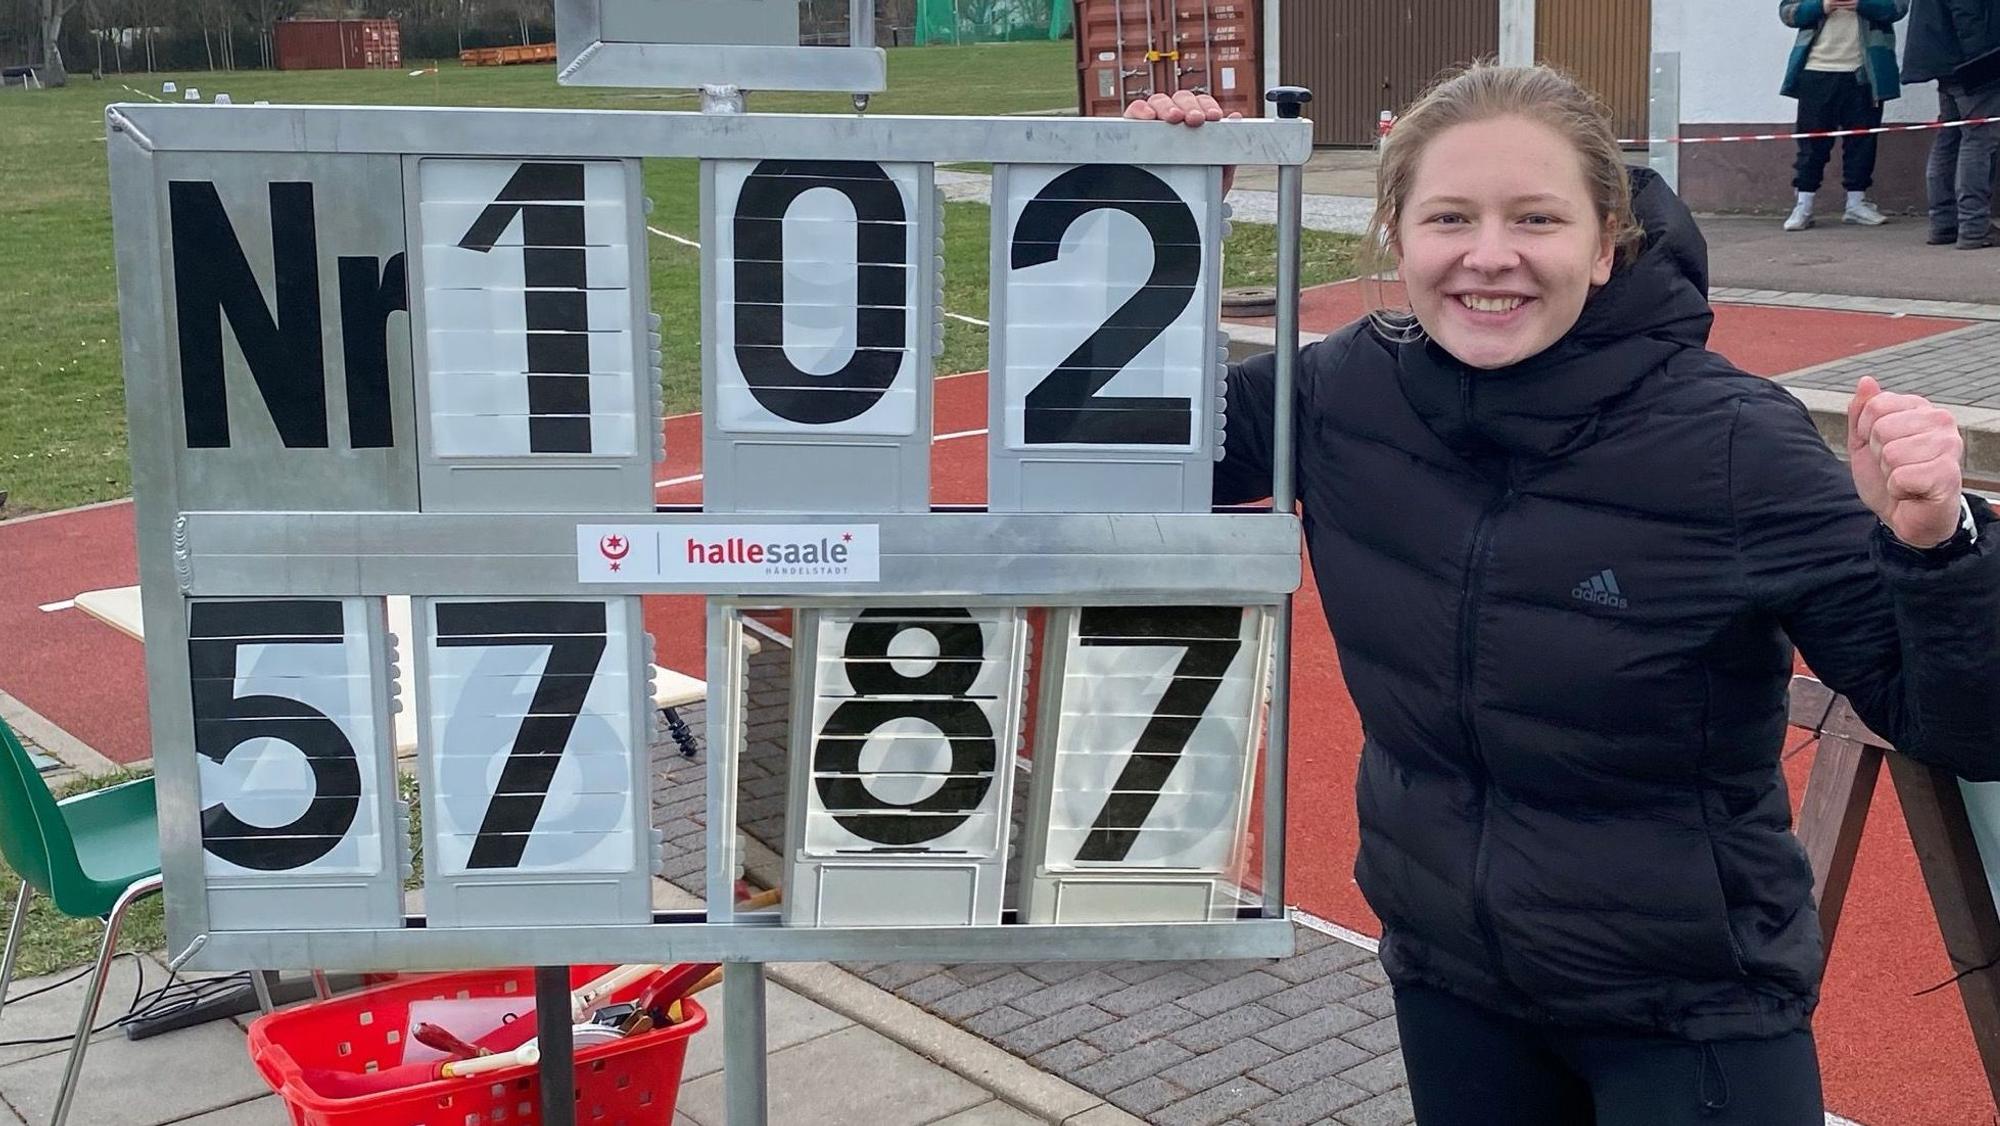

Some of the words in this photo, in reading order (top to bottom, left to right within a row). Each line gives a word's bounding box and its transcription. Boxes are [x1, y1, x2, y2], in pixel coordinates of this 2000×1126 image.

[169, 181, 407, 449] Nr
[687, 537, 848, 564] hallesaale
[1571, 587, 1628, 609] adidas
